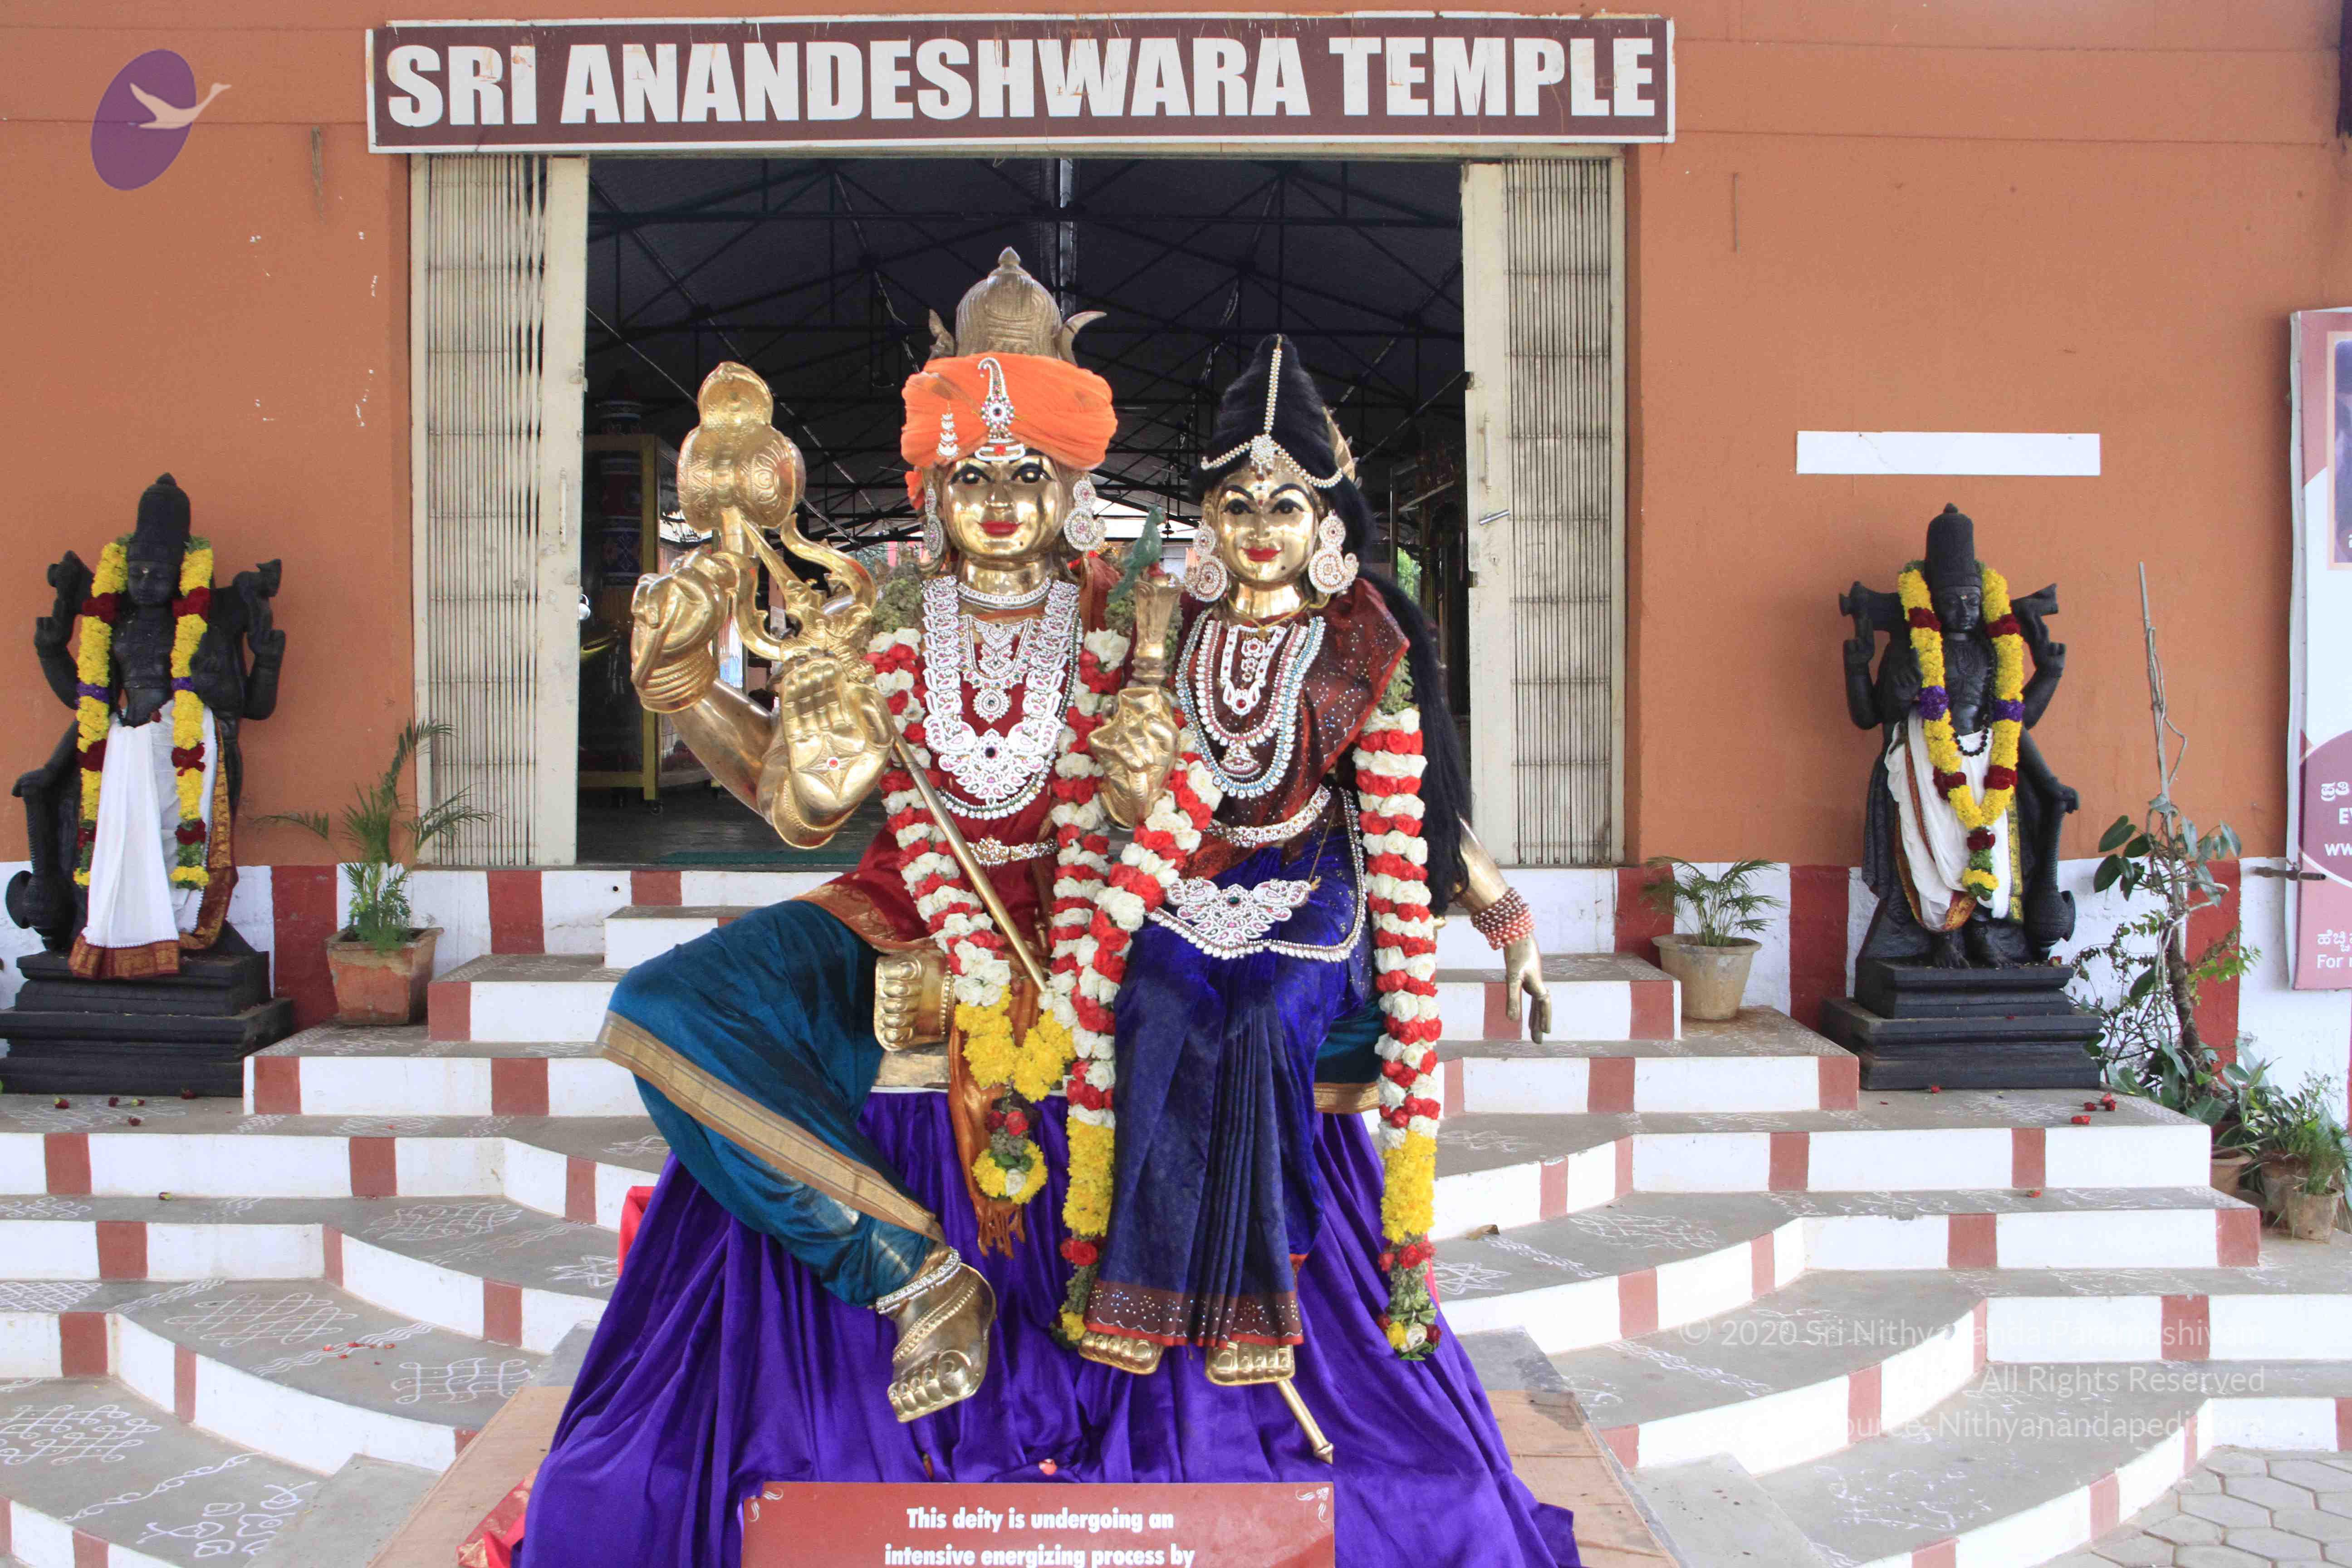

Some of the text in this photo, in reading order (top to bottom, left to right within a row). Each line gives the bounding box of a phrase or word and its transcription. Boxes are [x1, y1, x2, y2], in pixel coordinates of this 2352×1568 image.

[387, 36, 1656, 128] SRI ANANDESHWARA TEMPLE
[2317, 954, 2344, 968] For
[906, 1507, 1174, 1533] This deity is undergoing an
[885, 1543, 1196, 1568] intensive energizing process by
